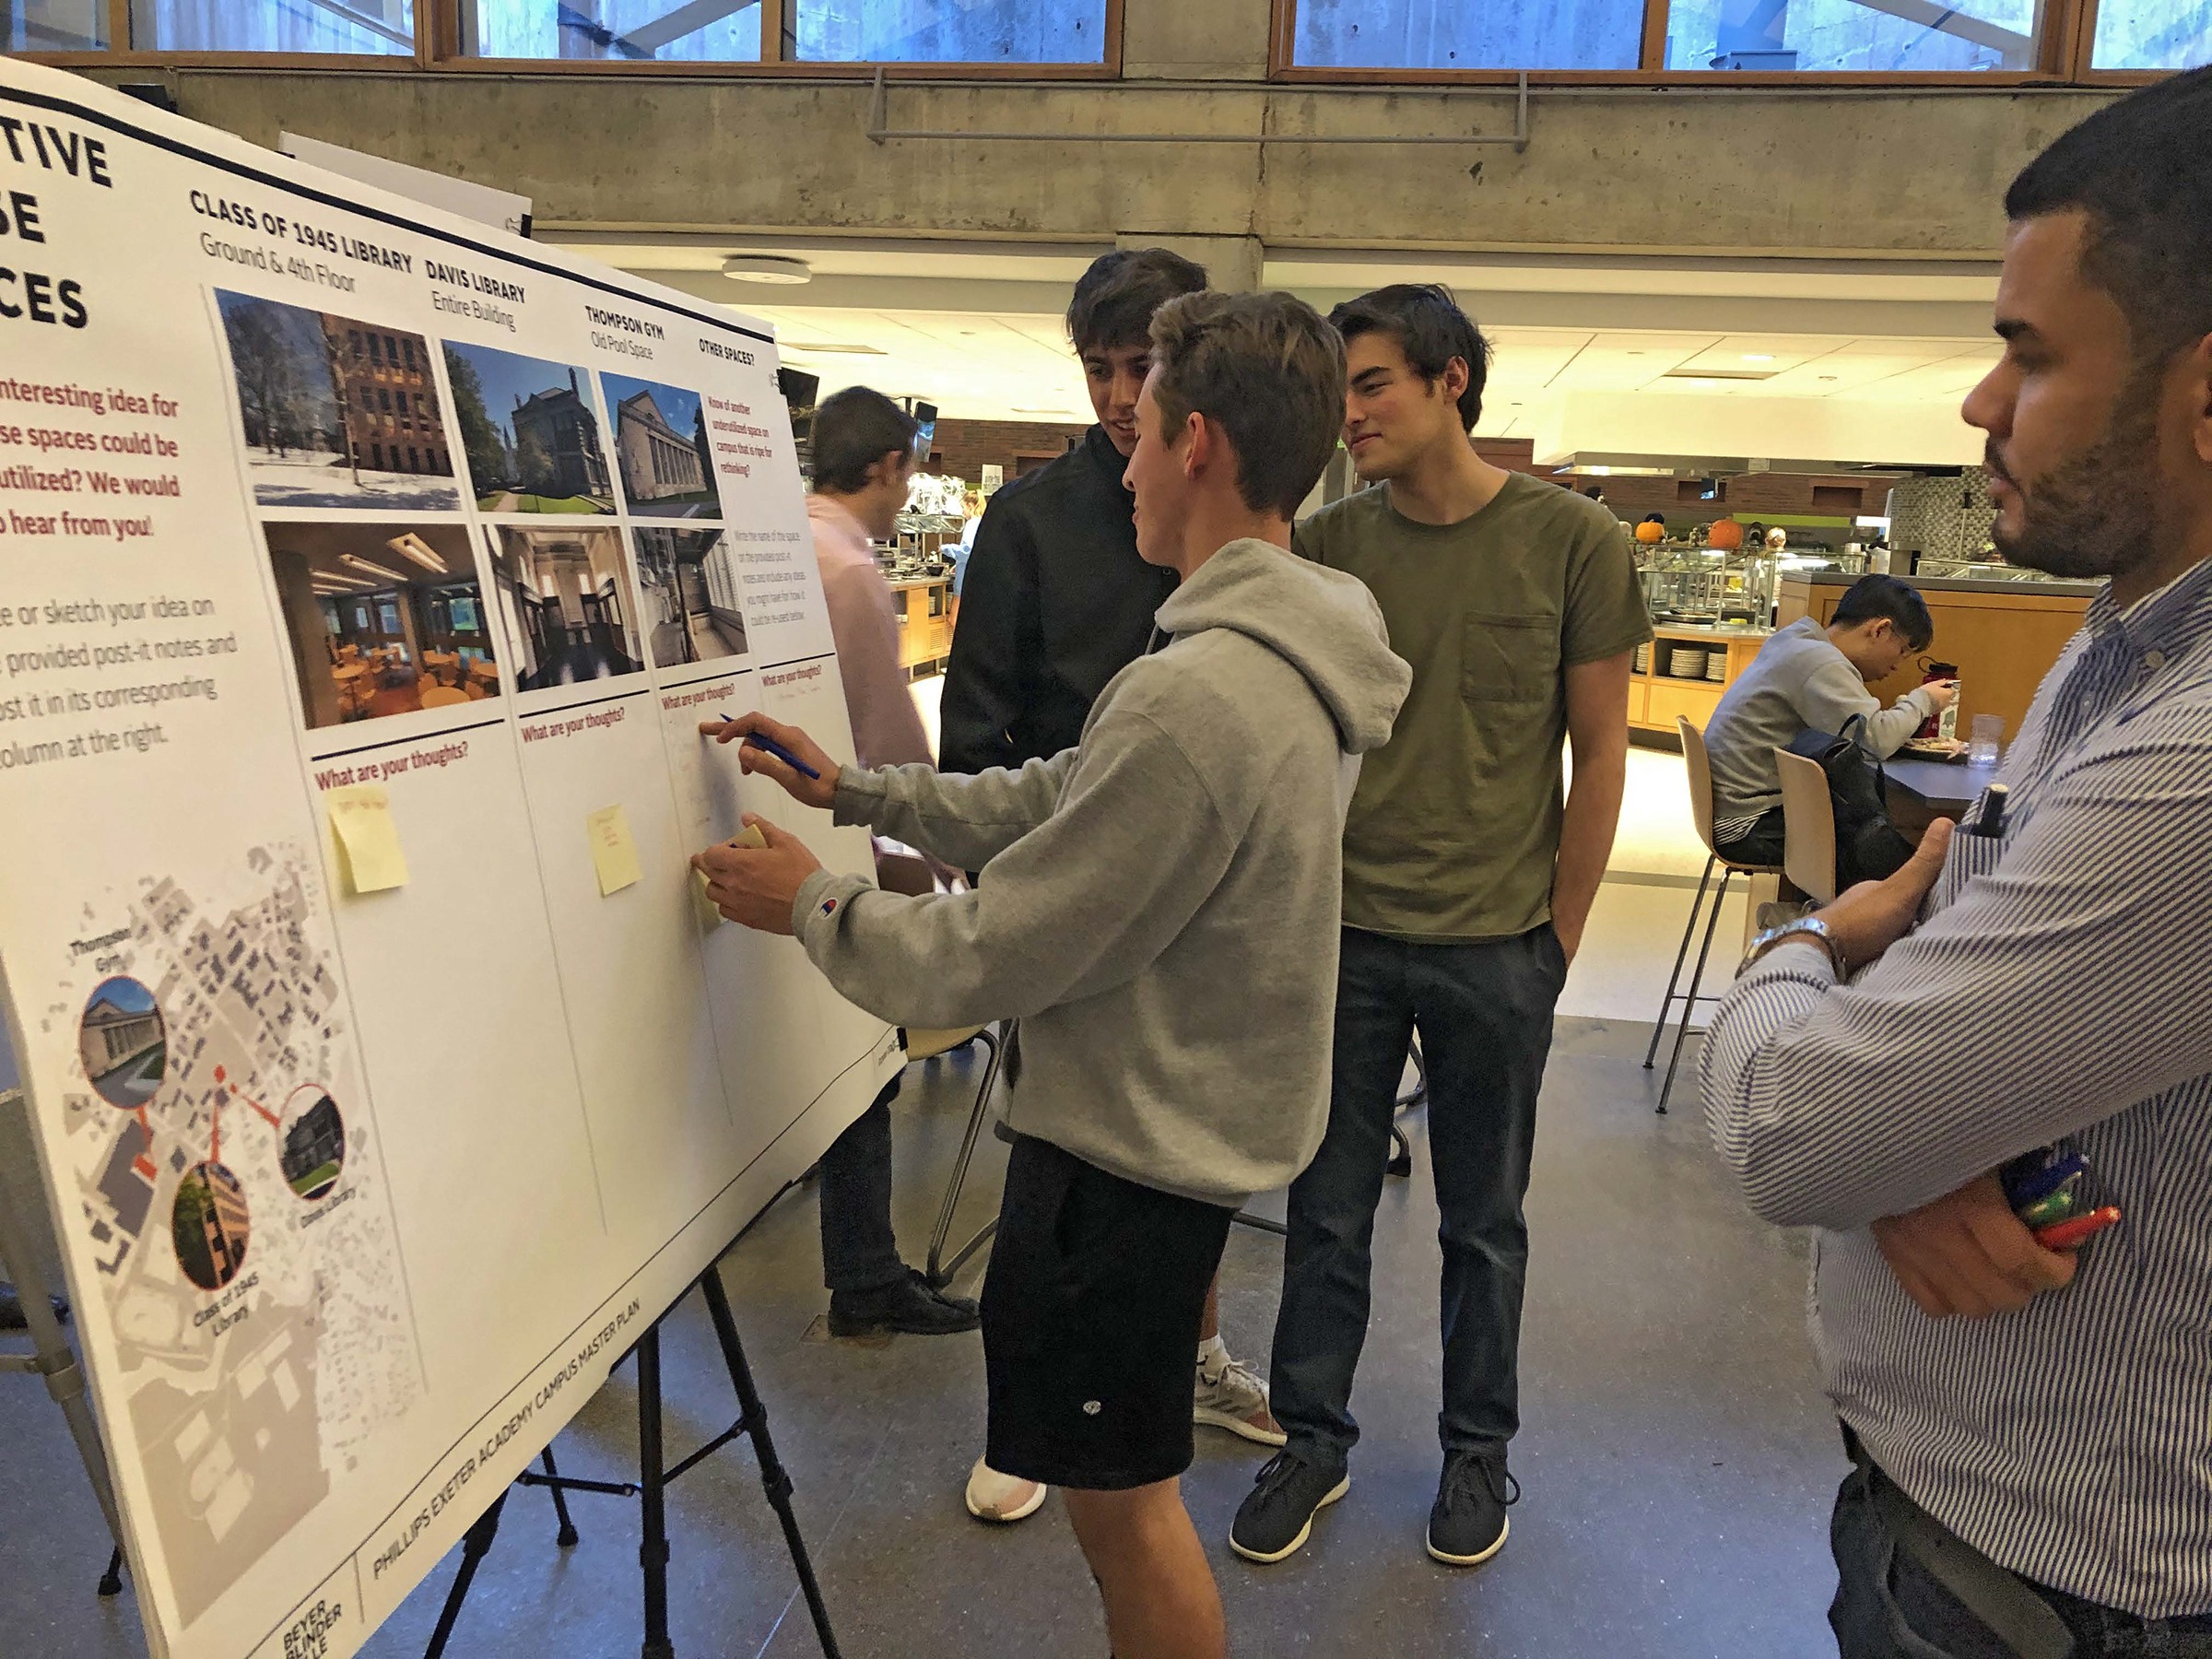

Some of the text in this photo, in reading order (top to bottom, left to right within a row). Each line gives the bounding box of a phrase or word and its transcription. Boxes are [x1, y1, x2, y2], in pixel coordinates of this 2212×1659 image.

[0, 115, 112, 188] TIVE
[189, 189, 412, 274] CLASS OF 1945 LIBRARY
[200, 231, 356, 293] Ground & 4th Floor
[425, 259, 525, 304] DAVIS LIBRARY
[0, 266, 88, 329] CES
[431, 290, 516, 333] Entire Building
[584, 305, 665, 341] THOMPSON GYM
[591, 331, 653, 361] Old Pool Space
[699, 338, 755, 367] OTHER SPACES?
[0, 378, 180, 418] nteresting idea for
[0, 424, 180, 458] se spaces could be
[0, 465, 182, 498] utilized? We would
[8, 509, 57, 535] hear
[61, 511, 112, 536] from
[112, 515, 155, 542] you!
[18, 605, 39, 626] or
[43, 597, 106, 625] sketch
[107, 602, 147, 628] your
[150, 594, 190, 618] idea
[191, 598, 216, 617] on
[6, 631, 239, 679] provided post-it notes and
[29, 690, 44, 717] it
[46, 689, 65, 715] in
[67, 687, 91, 713] its
[94, 676, 218, 708] corresponding
[662, 683, 735, 710] What are your thoughts?
[761, 674, 777, 687] What
[521, 706, 626, 743] What are your thoughts?
[0, 723, 169, 769] olumn at the right.
[314, 740, 469, 791] What are your thoughts?
[372, 1298, 641, 1581] PHILLIPS EXETER ACADEMY CAMPUS MASTER PLAN
[283, 1599, 325, 1651] BEYER
[286, 1603, 341, 1659] BLINDER
[305, 1636, 328, 1659] LE
